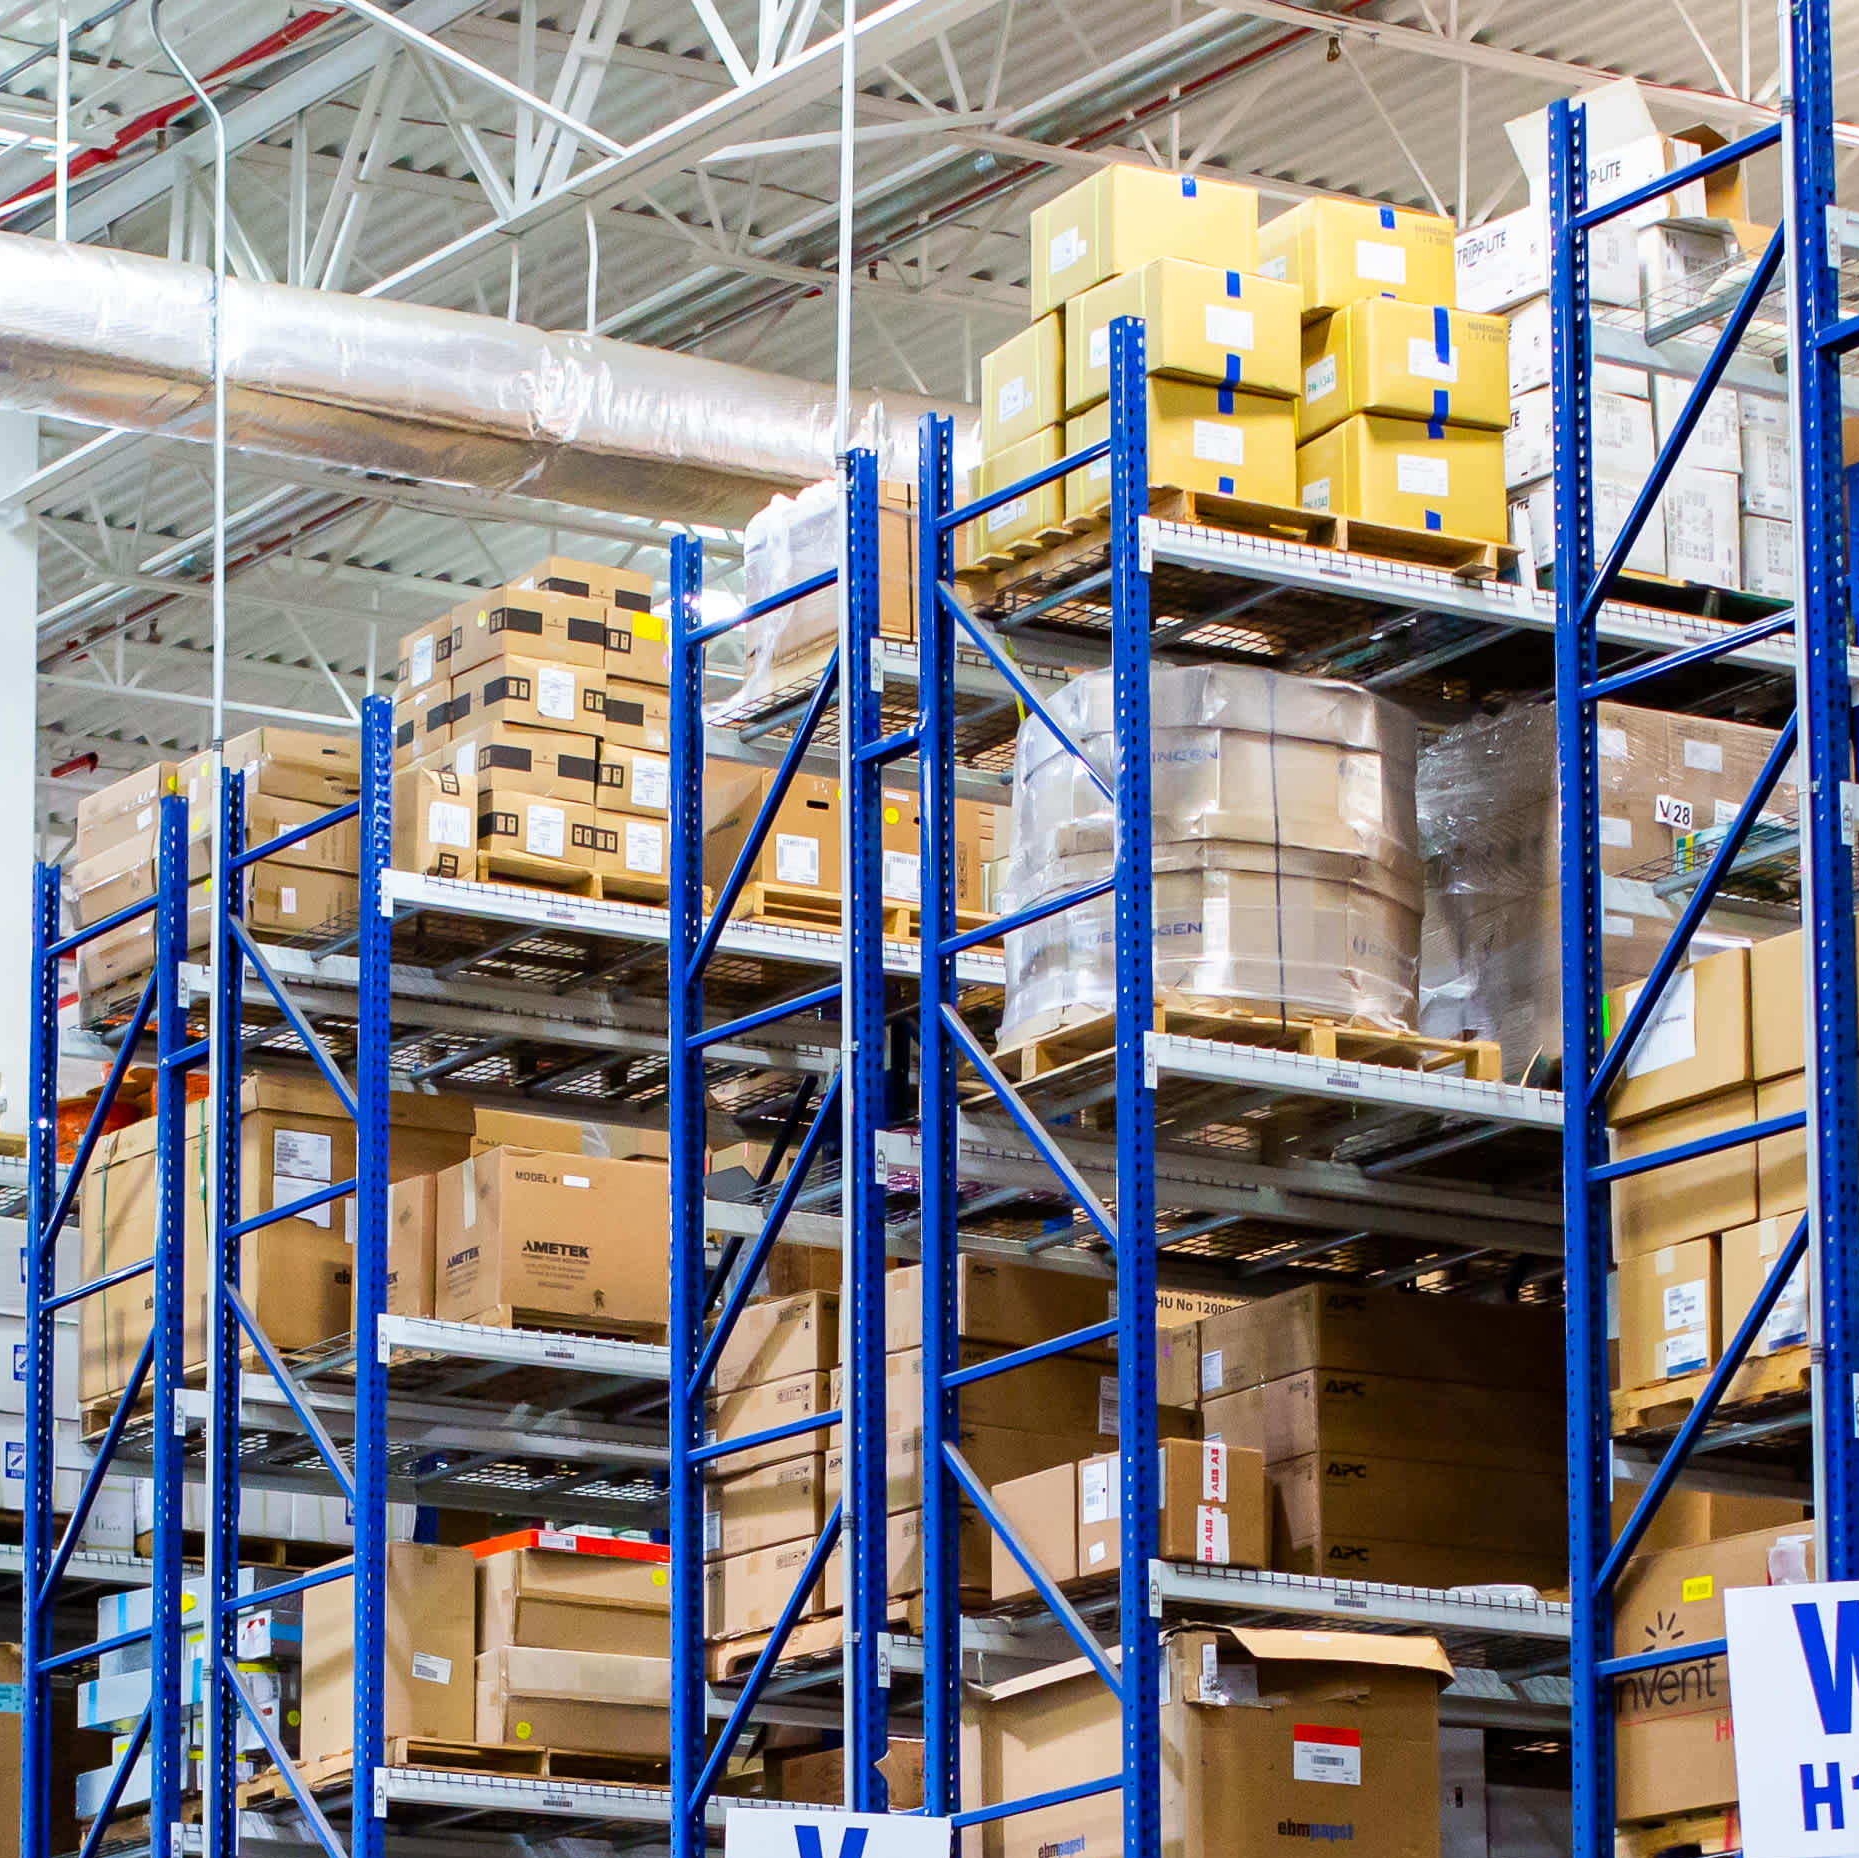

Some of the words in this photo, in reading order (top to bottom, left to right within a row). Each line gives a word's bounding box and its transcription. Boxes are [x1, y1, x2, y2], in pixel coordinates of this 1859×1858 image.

[1659, 800, 1670, 818] V
[1673, 804, 1691, 826] 28
[515, 1171, 549, 1184] MODEL
[447, 1247, 480, 1268] AMETEK
[522, 1240, 591, 1259] AMETEK
[1176, 1298, 1193, 1311] No
[1326, 1295, 1366, 1310] APC
[1326, 1380, 1366, 1396] APC
[1326, 1463, 1367, 1479] APC
[1211, 1469, 1220, 1493] ABB
[1205, 1519, 1214, 1543] ABB
[1329, 1546, 1370, 1562] APC
[1277, 1818, 1354, 1843] ebmpapst
